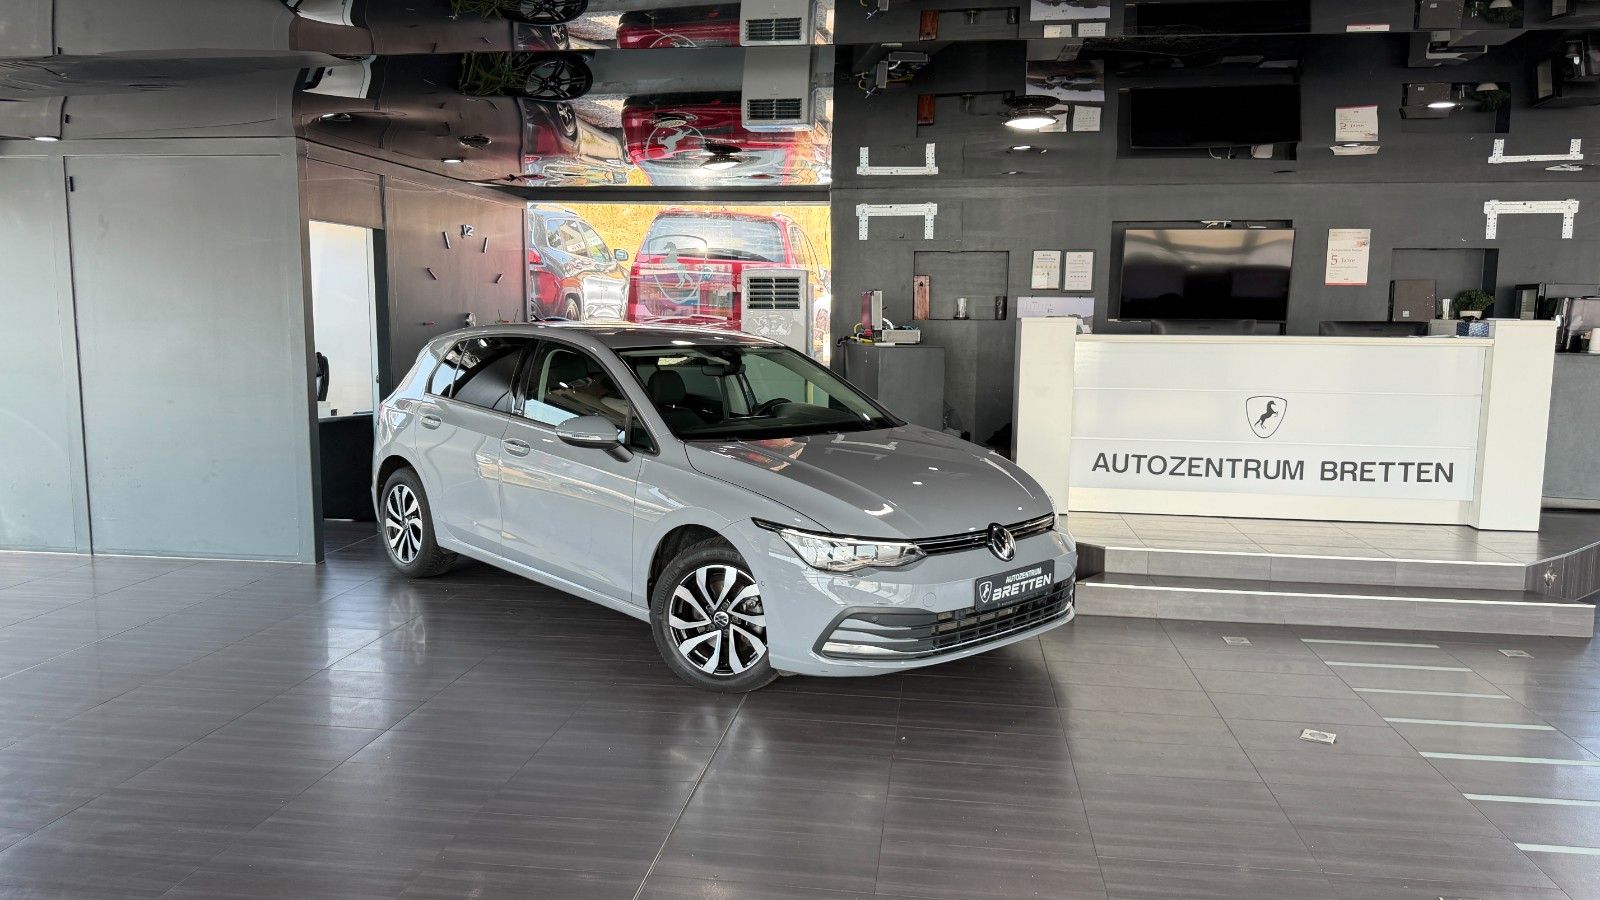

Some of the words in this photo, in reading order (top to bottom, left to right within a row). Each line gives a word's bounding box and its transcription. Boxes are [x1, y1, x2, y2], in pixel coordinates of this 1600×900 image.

[462, 224, 474, 237] 12
[1330, 254, 1338, 265] 5
[1091, 452, 1305, 481] AUTOZENTRUM
[1320, 460, 1454, 483] BRETTEN
[1005, 567, 1042, 584] AUTOZENTRUM
[992, 573, 1052, 601] BRETTEN
